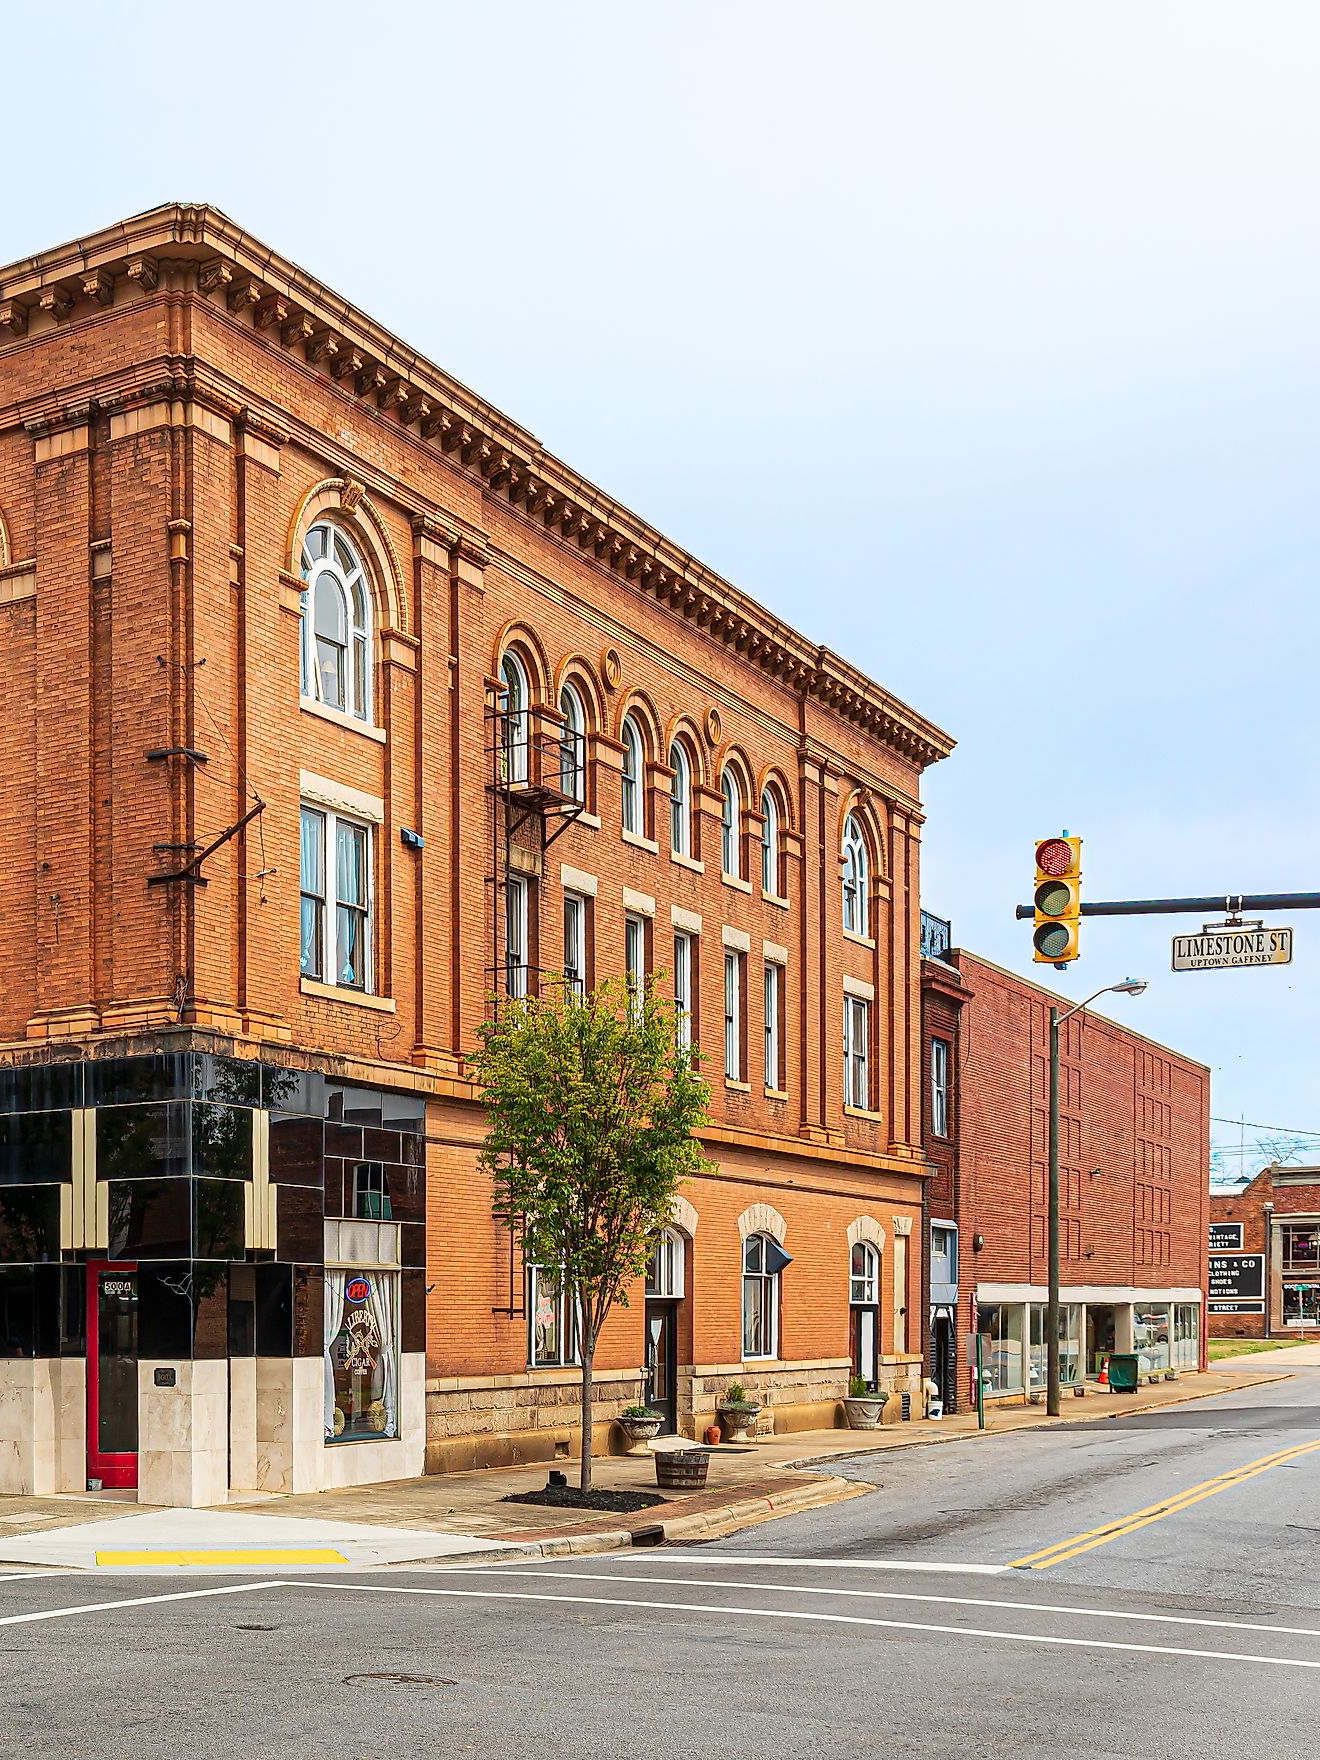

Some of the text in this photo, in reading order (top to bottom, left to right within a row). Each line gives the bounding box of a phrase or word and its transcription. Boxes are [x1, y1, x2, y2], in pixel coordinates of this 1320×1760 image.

[1177, 932, 1287, 958] LIMESTONE ST
[1190, 954, 1273, 967] UPTOWN GAFFNEY
[1241, 1260, 1255, 1268] CO
[105, 1282, 131, 1291] 500A
[349, 1284, 369, 1298] OPEN
[347, 1310, 377, 1328] LIBERTY
[352, 1358, 370, 1367] CIGAR
